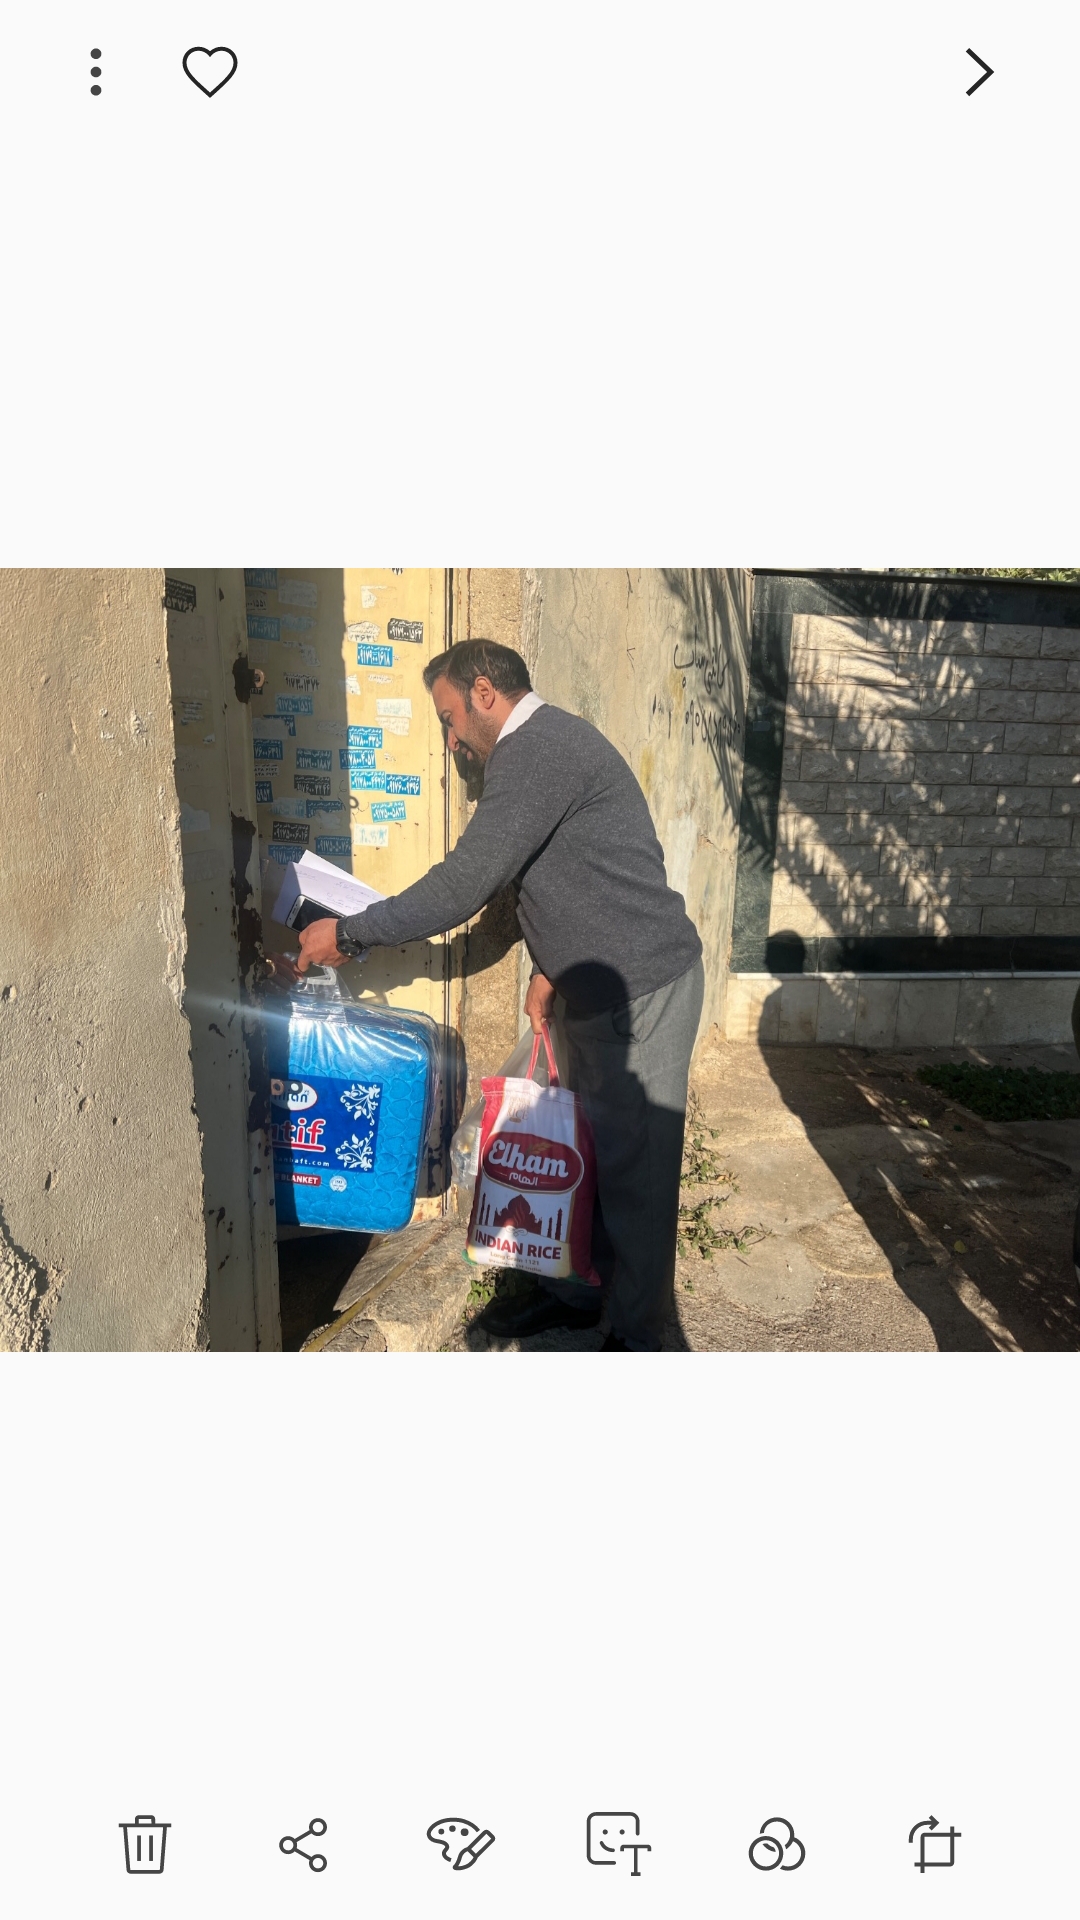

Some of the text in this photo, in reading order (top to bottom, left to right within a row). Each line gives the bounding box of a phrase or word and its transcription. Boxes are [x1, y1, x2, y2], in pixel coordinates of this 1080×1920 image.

[488, 1139, 569, 1179] Elham
[281, 1172, 319, 1185] BLANKET
[508, 1171, 539, 1187] الهام
[475, 1228, 562, 1260] INDIAN RICE
[524, 1256, 540, 1266] 1121
